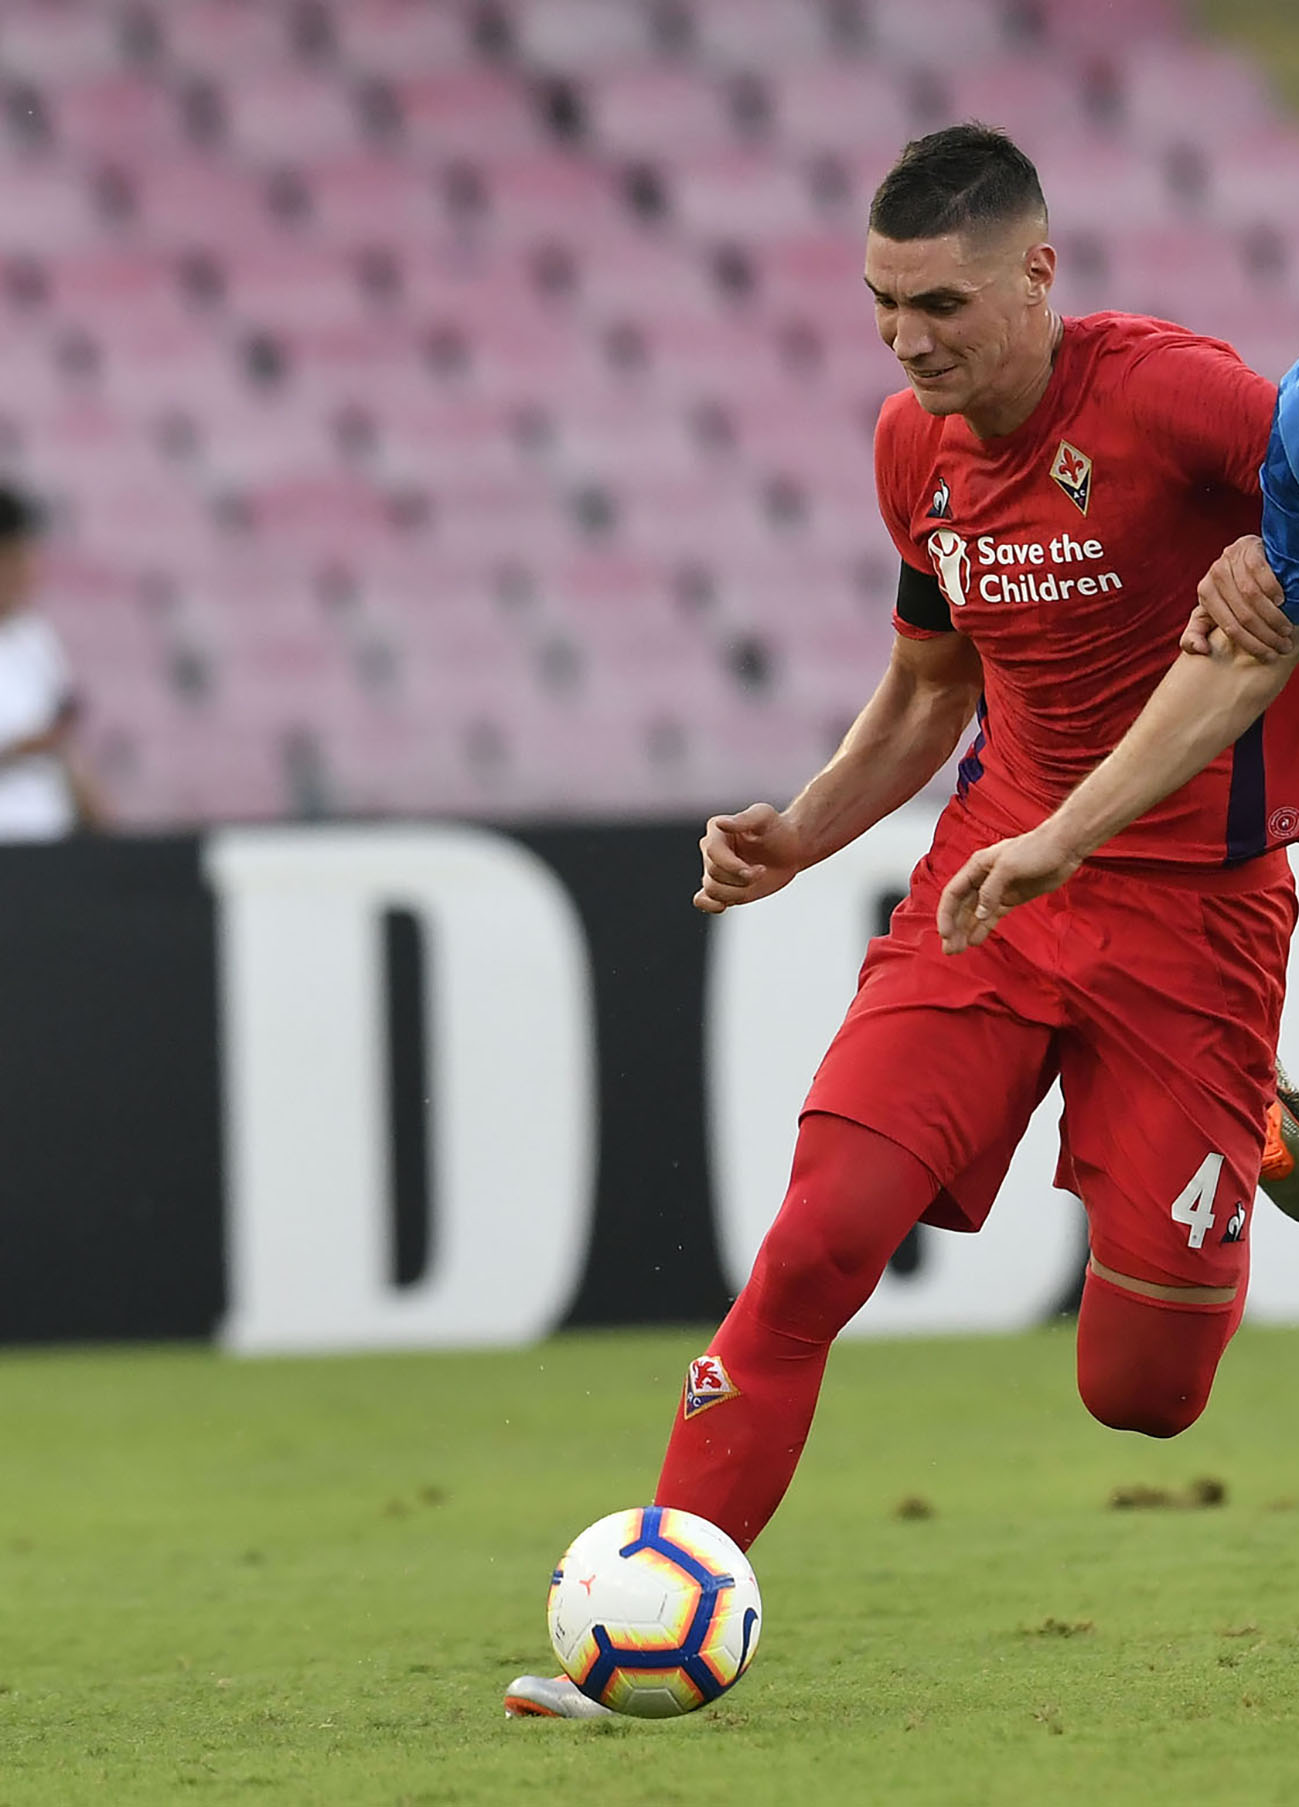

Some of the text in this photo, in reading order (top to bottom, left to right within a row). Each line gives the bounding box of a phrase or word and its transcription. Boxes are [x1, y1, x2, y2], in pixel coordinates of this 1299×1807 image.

[977, 533, 1104, 565] Save the
[979, 571, 1123, 603] Children
[1171, 1152, 1225, 1248] 4
